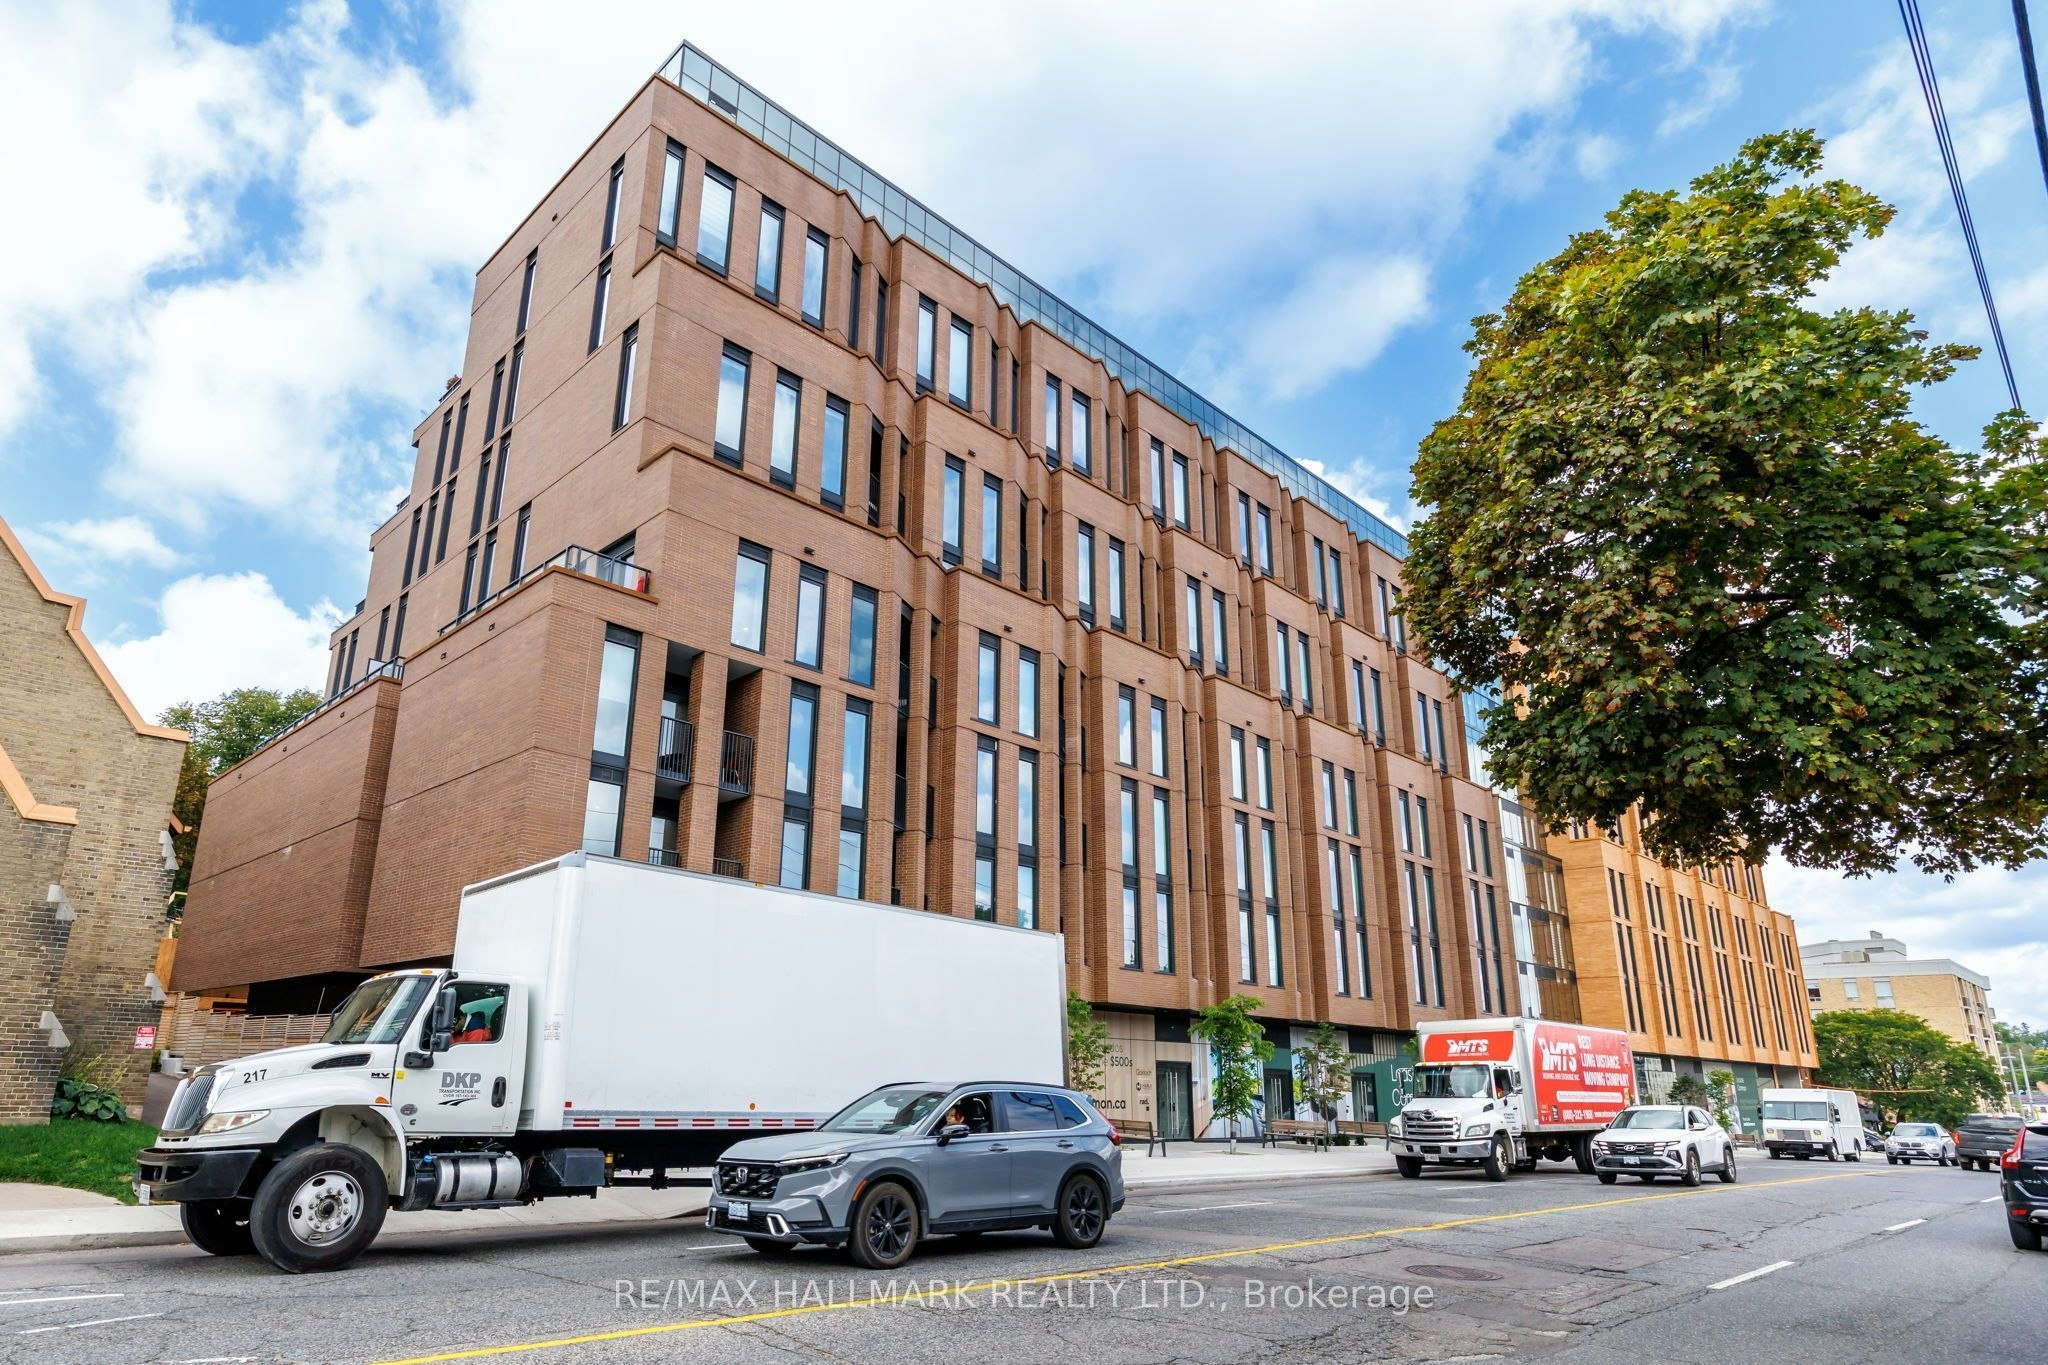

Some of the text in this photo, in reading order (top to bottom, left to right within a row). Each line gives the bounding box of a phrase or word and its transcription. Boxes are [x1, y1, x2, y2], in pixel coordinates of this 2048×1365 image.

[1110, 1056, 1132, 1068] $500s
[244, 1069, 267, 1083] 217
[441, 1072, 481, 1088] DKP
[1605, 1072, 1630, 1087] COMPANY
